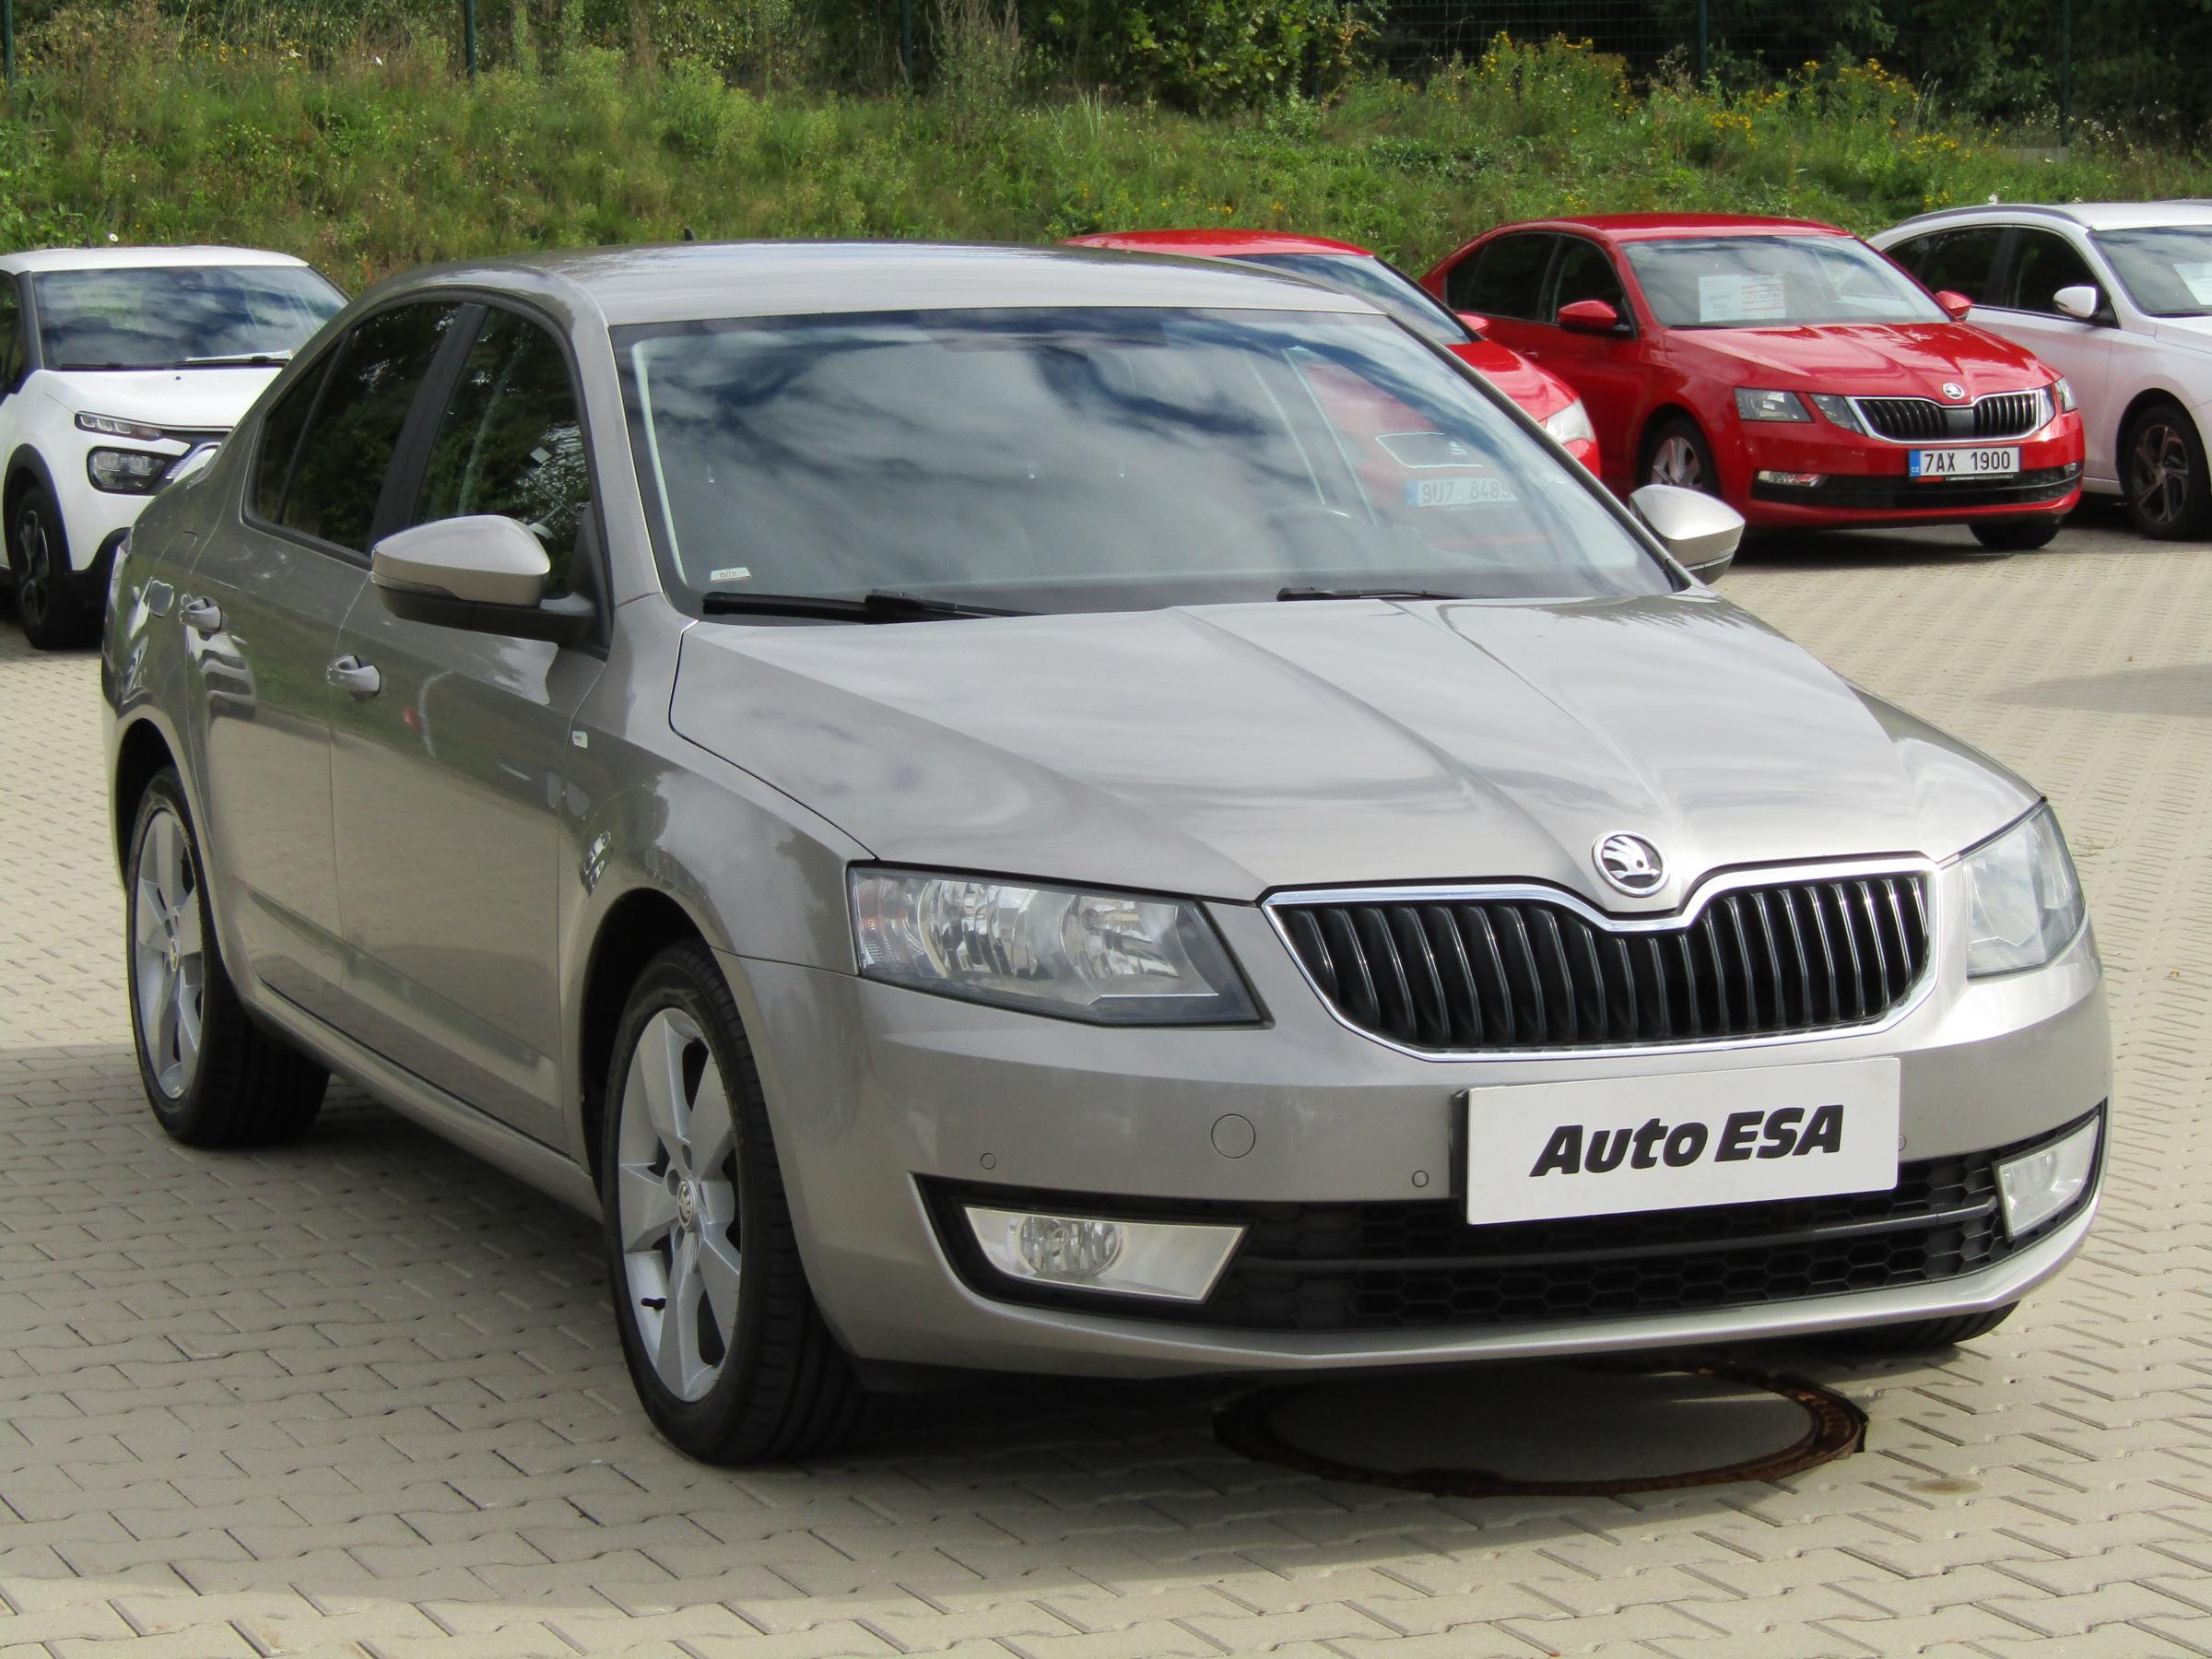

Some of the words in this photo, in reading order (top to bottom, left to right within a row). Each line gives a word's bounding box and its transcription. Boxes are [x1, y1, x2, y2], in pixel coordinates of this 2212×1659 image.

[1924, 452, 1956, 473] 7AX
[1971, 451, 2011, 471] 1900
[1422, 482, 1455, 503] 9U7
[1528, 1117, 1709, 1178] Auto
[1713, 1104, 1844, 1164] ESA
